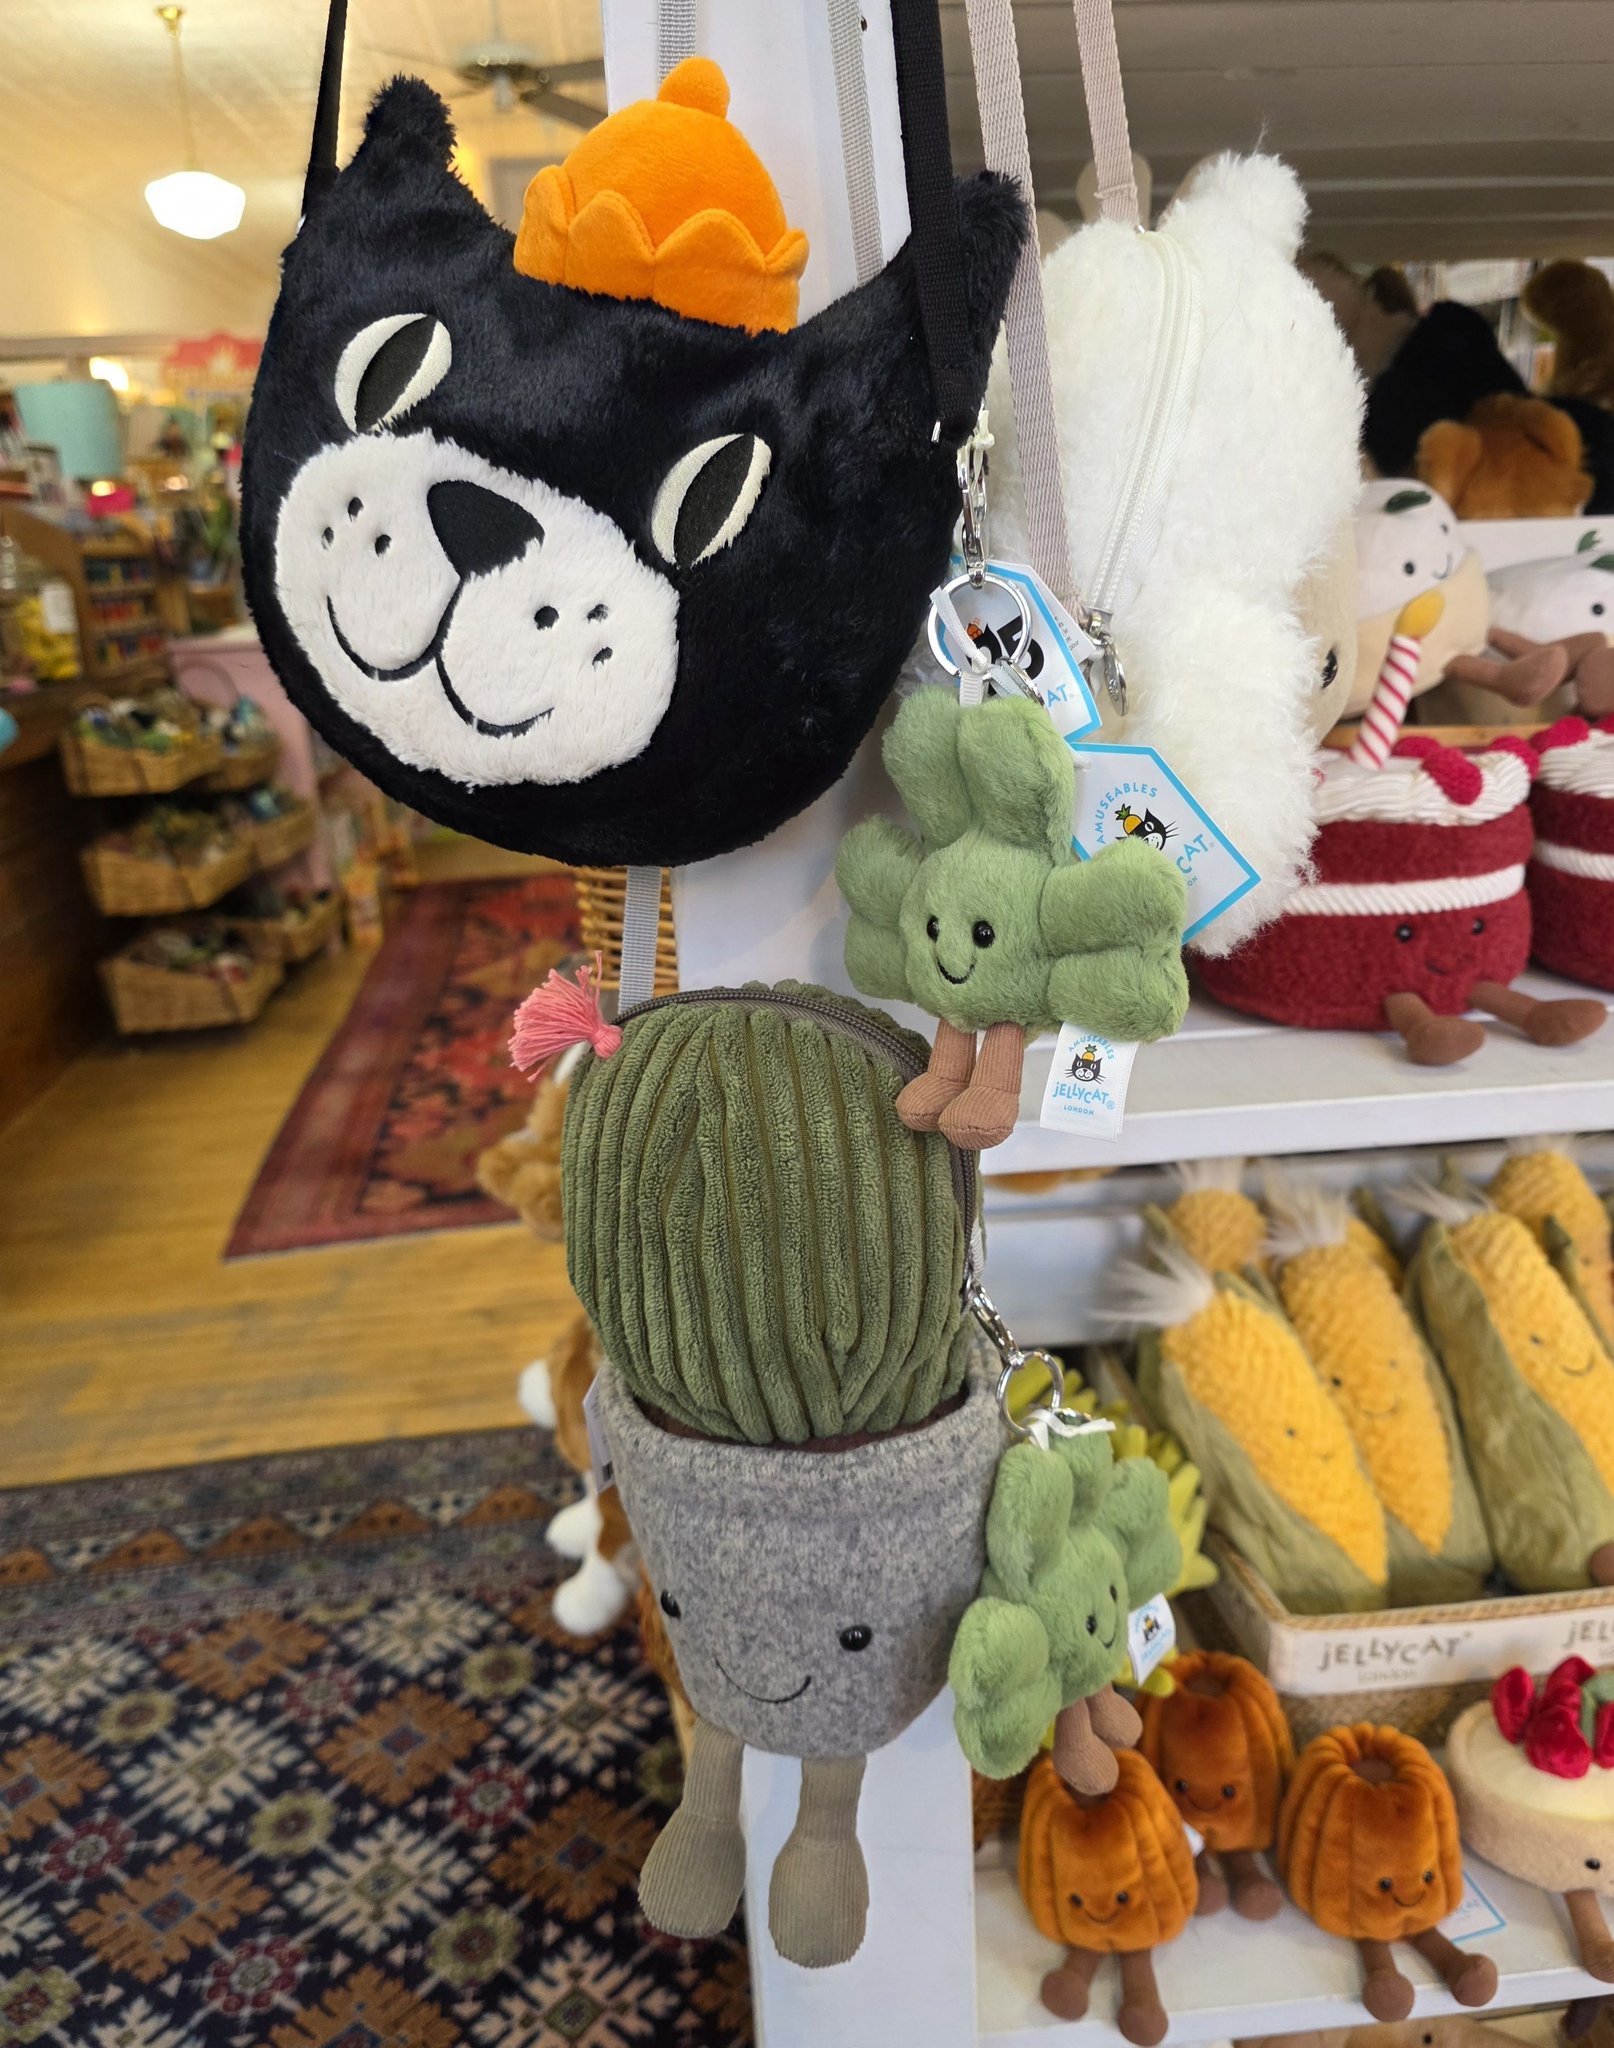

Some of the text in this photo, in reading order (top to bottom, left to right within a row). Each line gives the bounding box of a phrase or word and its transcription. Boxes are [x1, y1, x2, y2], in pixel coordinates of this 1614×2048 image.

[1094, 782, 1158, 845] AMUSEABLES
[1068, 1034, 1115, 1060] AMUSEABLES
[1063, 1104, 1095, 1116] LONDON
